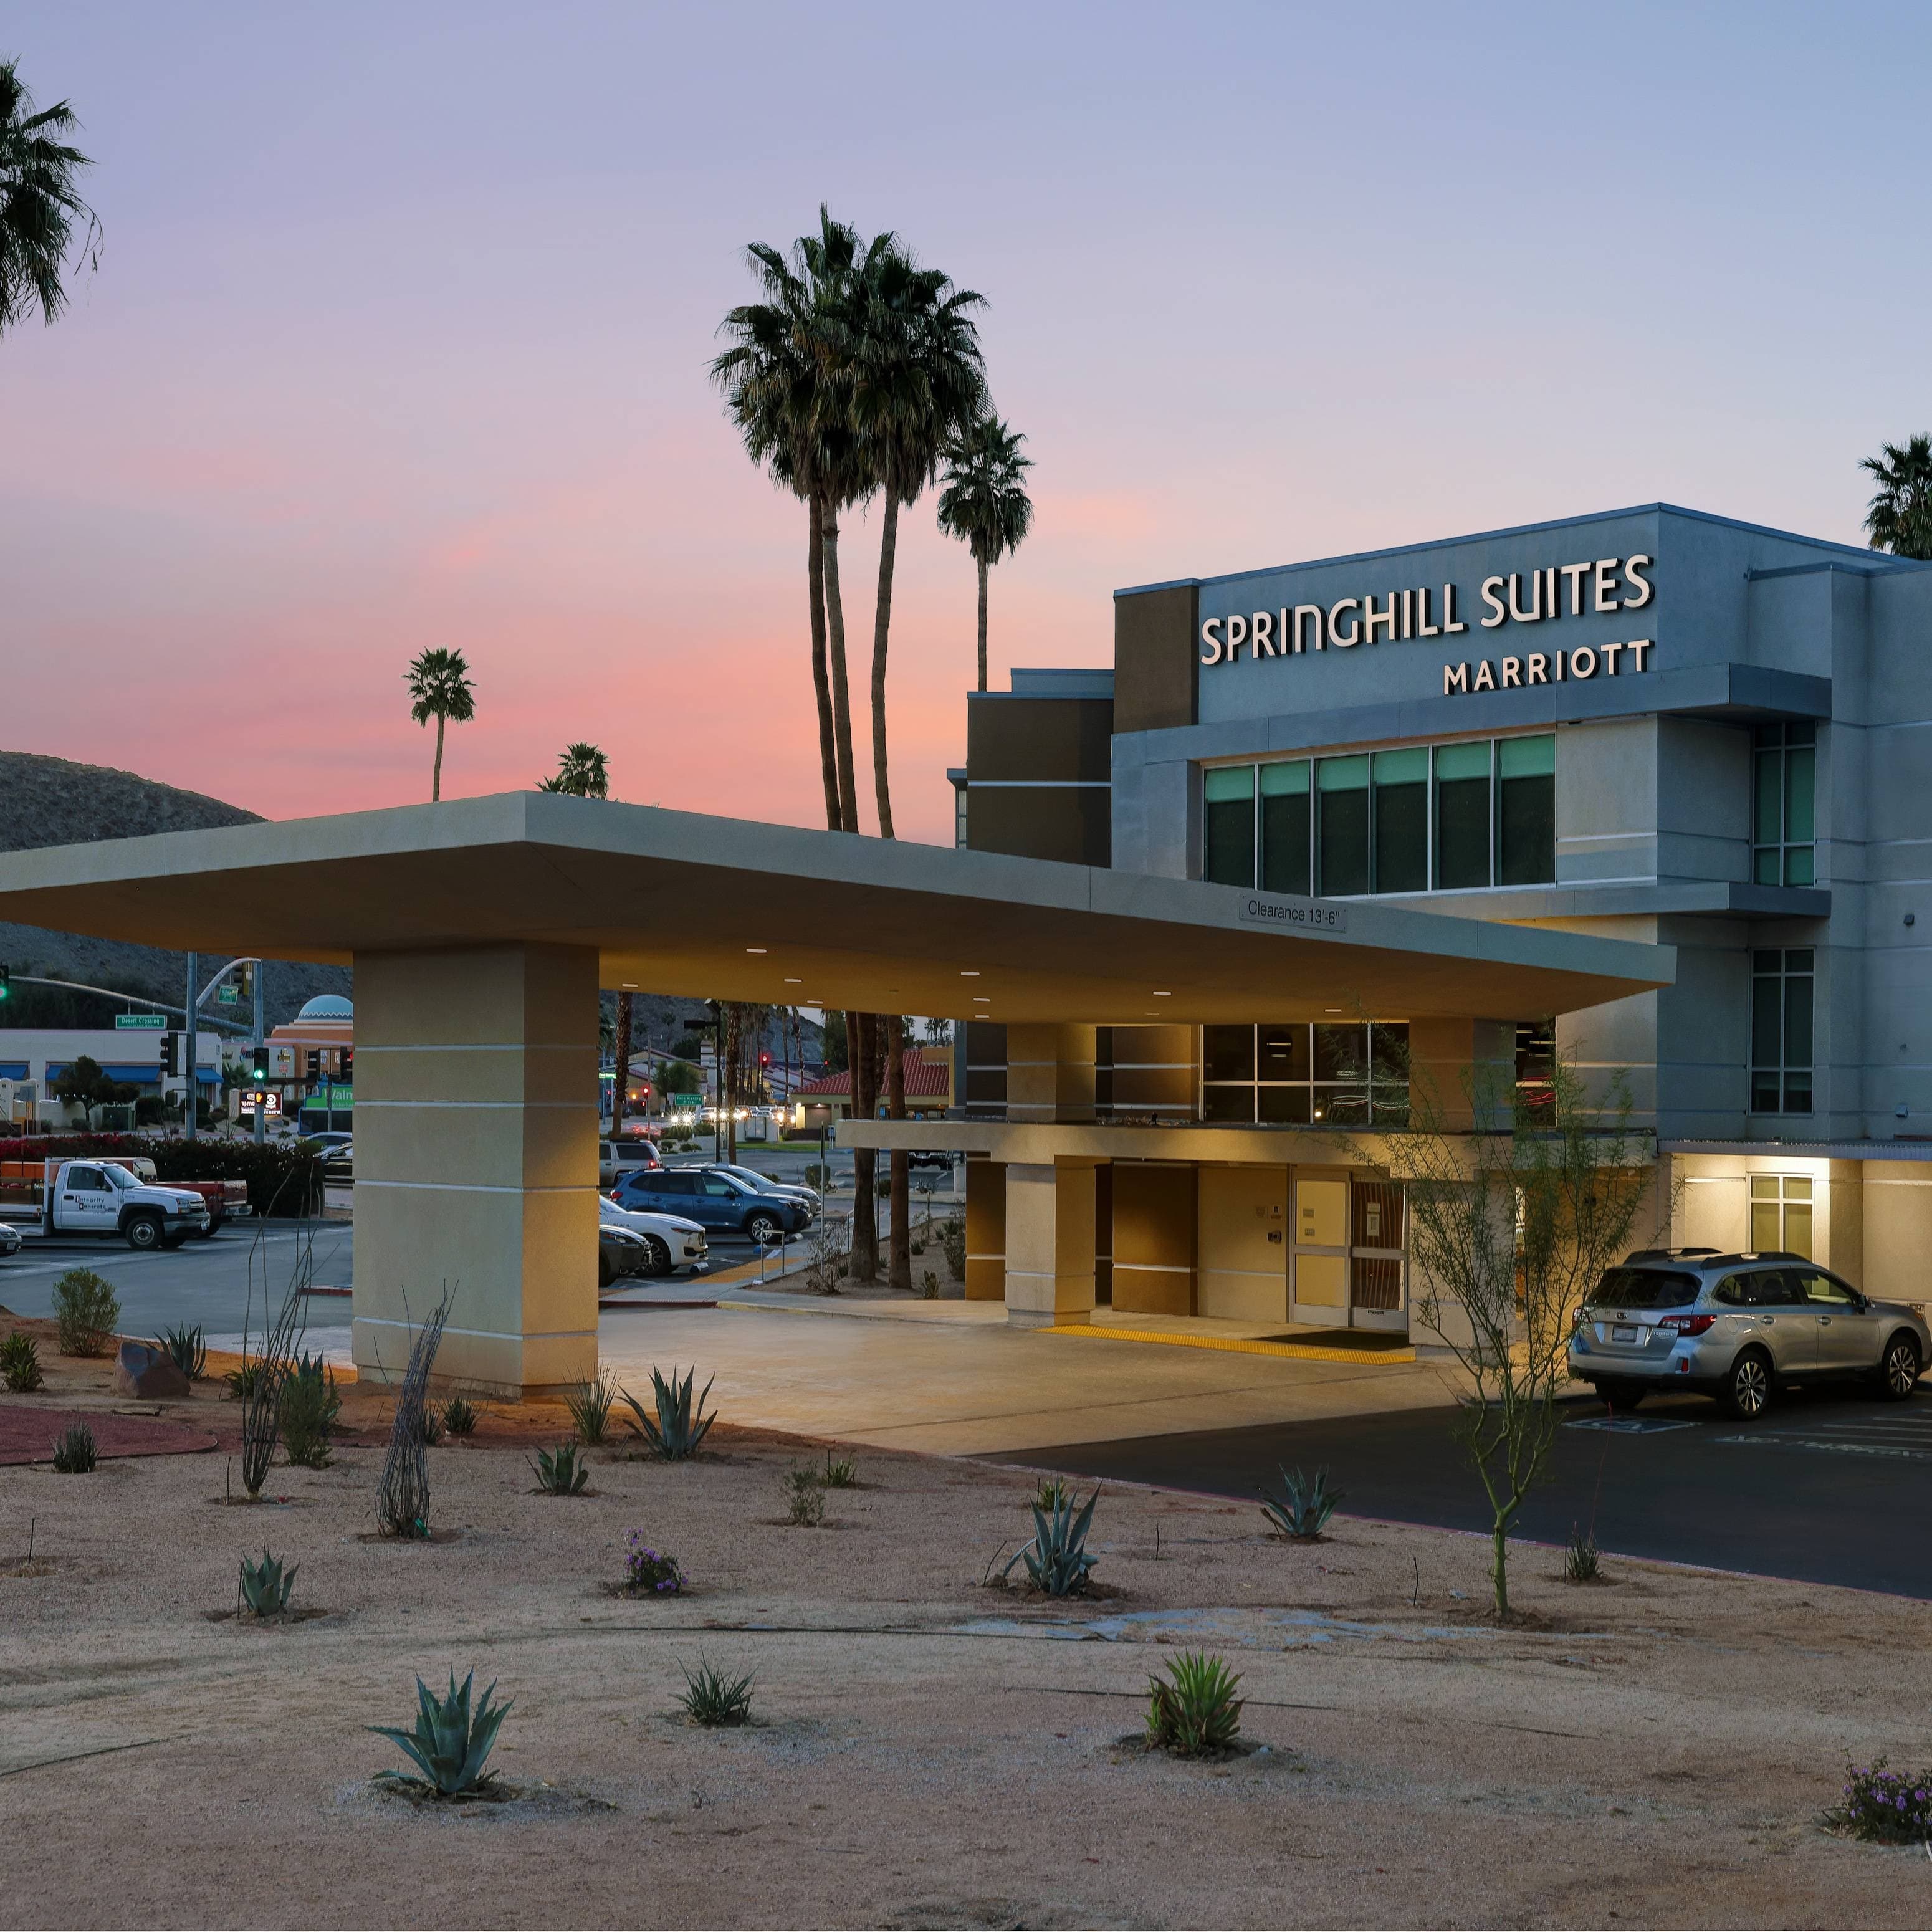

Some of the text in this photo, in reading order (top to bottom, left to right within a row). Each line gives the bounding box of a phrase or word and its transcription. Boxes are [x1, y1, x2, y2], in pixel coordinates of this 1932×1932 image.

[1200, 554, 1655, 666] SPRINGHILL SUITES
[1443, 639, 1653, 696] MARRIOTT
[1248, 900, 1340, 925] Clearance 13'-6"
[138, 1016, 160, 1026] Crossing
